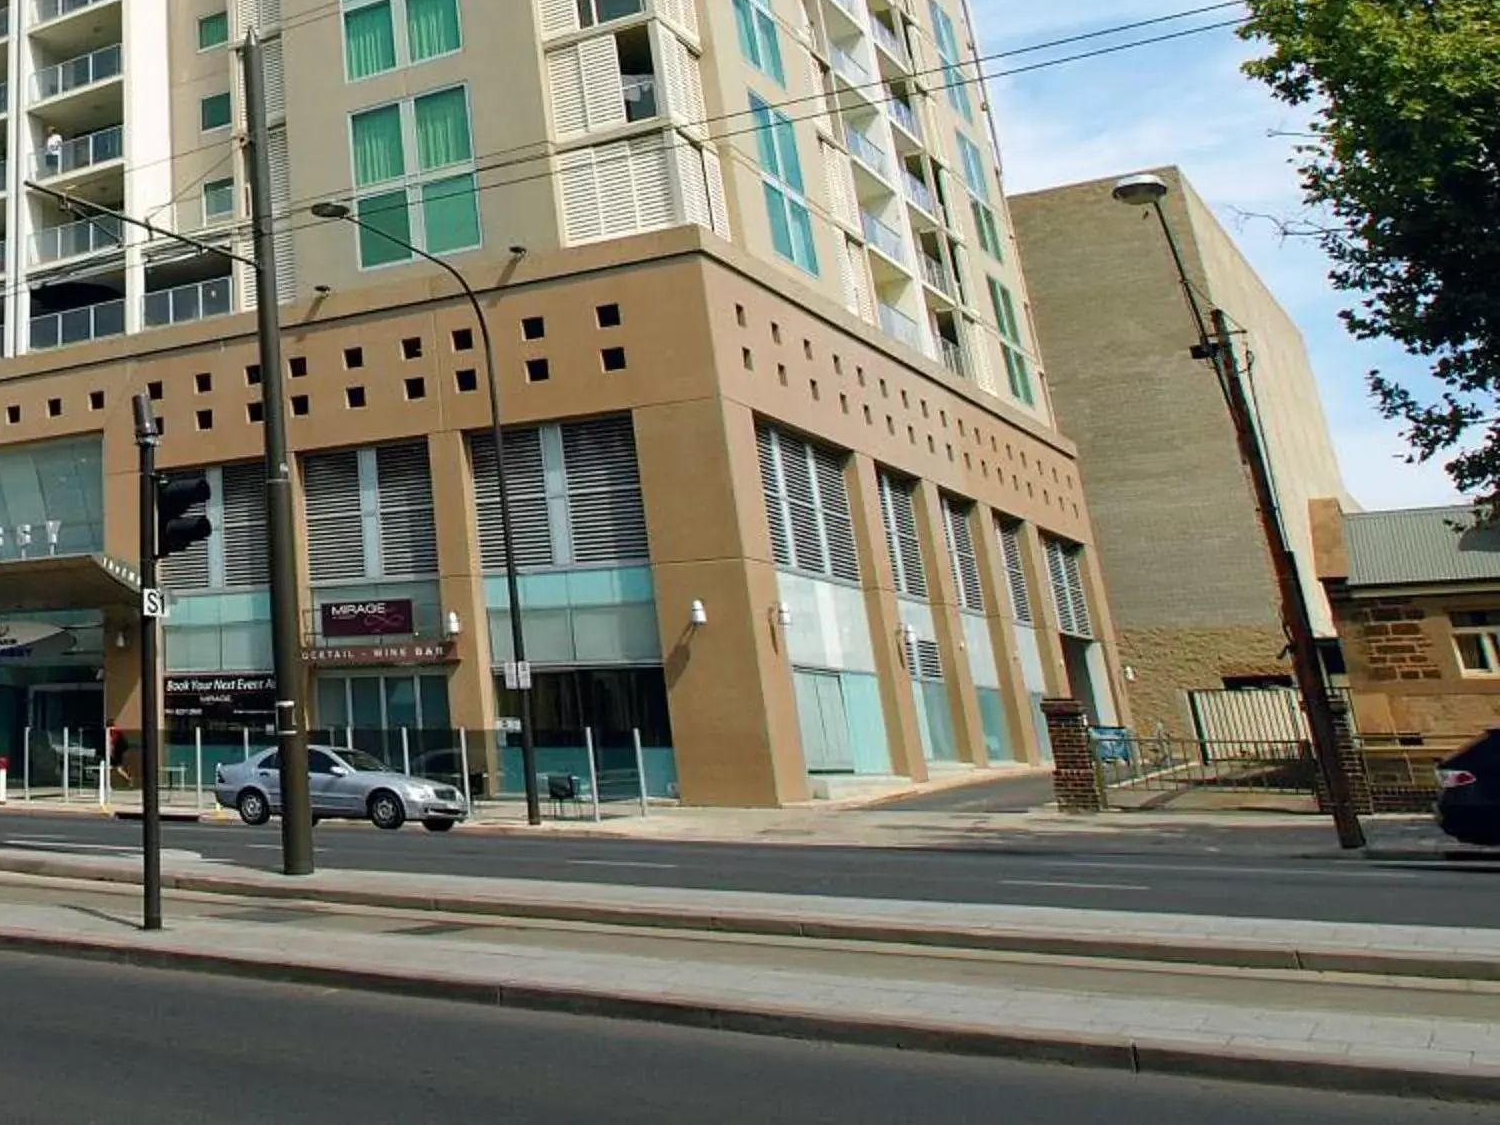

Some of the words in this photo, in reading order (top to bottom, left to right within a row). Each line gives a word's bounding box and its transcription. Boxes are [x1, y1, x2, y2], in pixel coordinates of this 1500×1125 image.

[147, 592, 166, 615] S1
[331, 603, 386, 615] MIRAGE
[301, 651, 354, 660] OCKTAIL
[415, 647, 443, 656] BAR
[167, 680, 189, 691] Book
[192, 679, 213, 690] Your
[214, 679, 235, 690] Next
